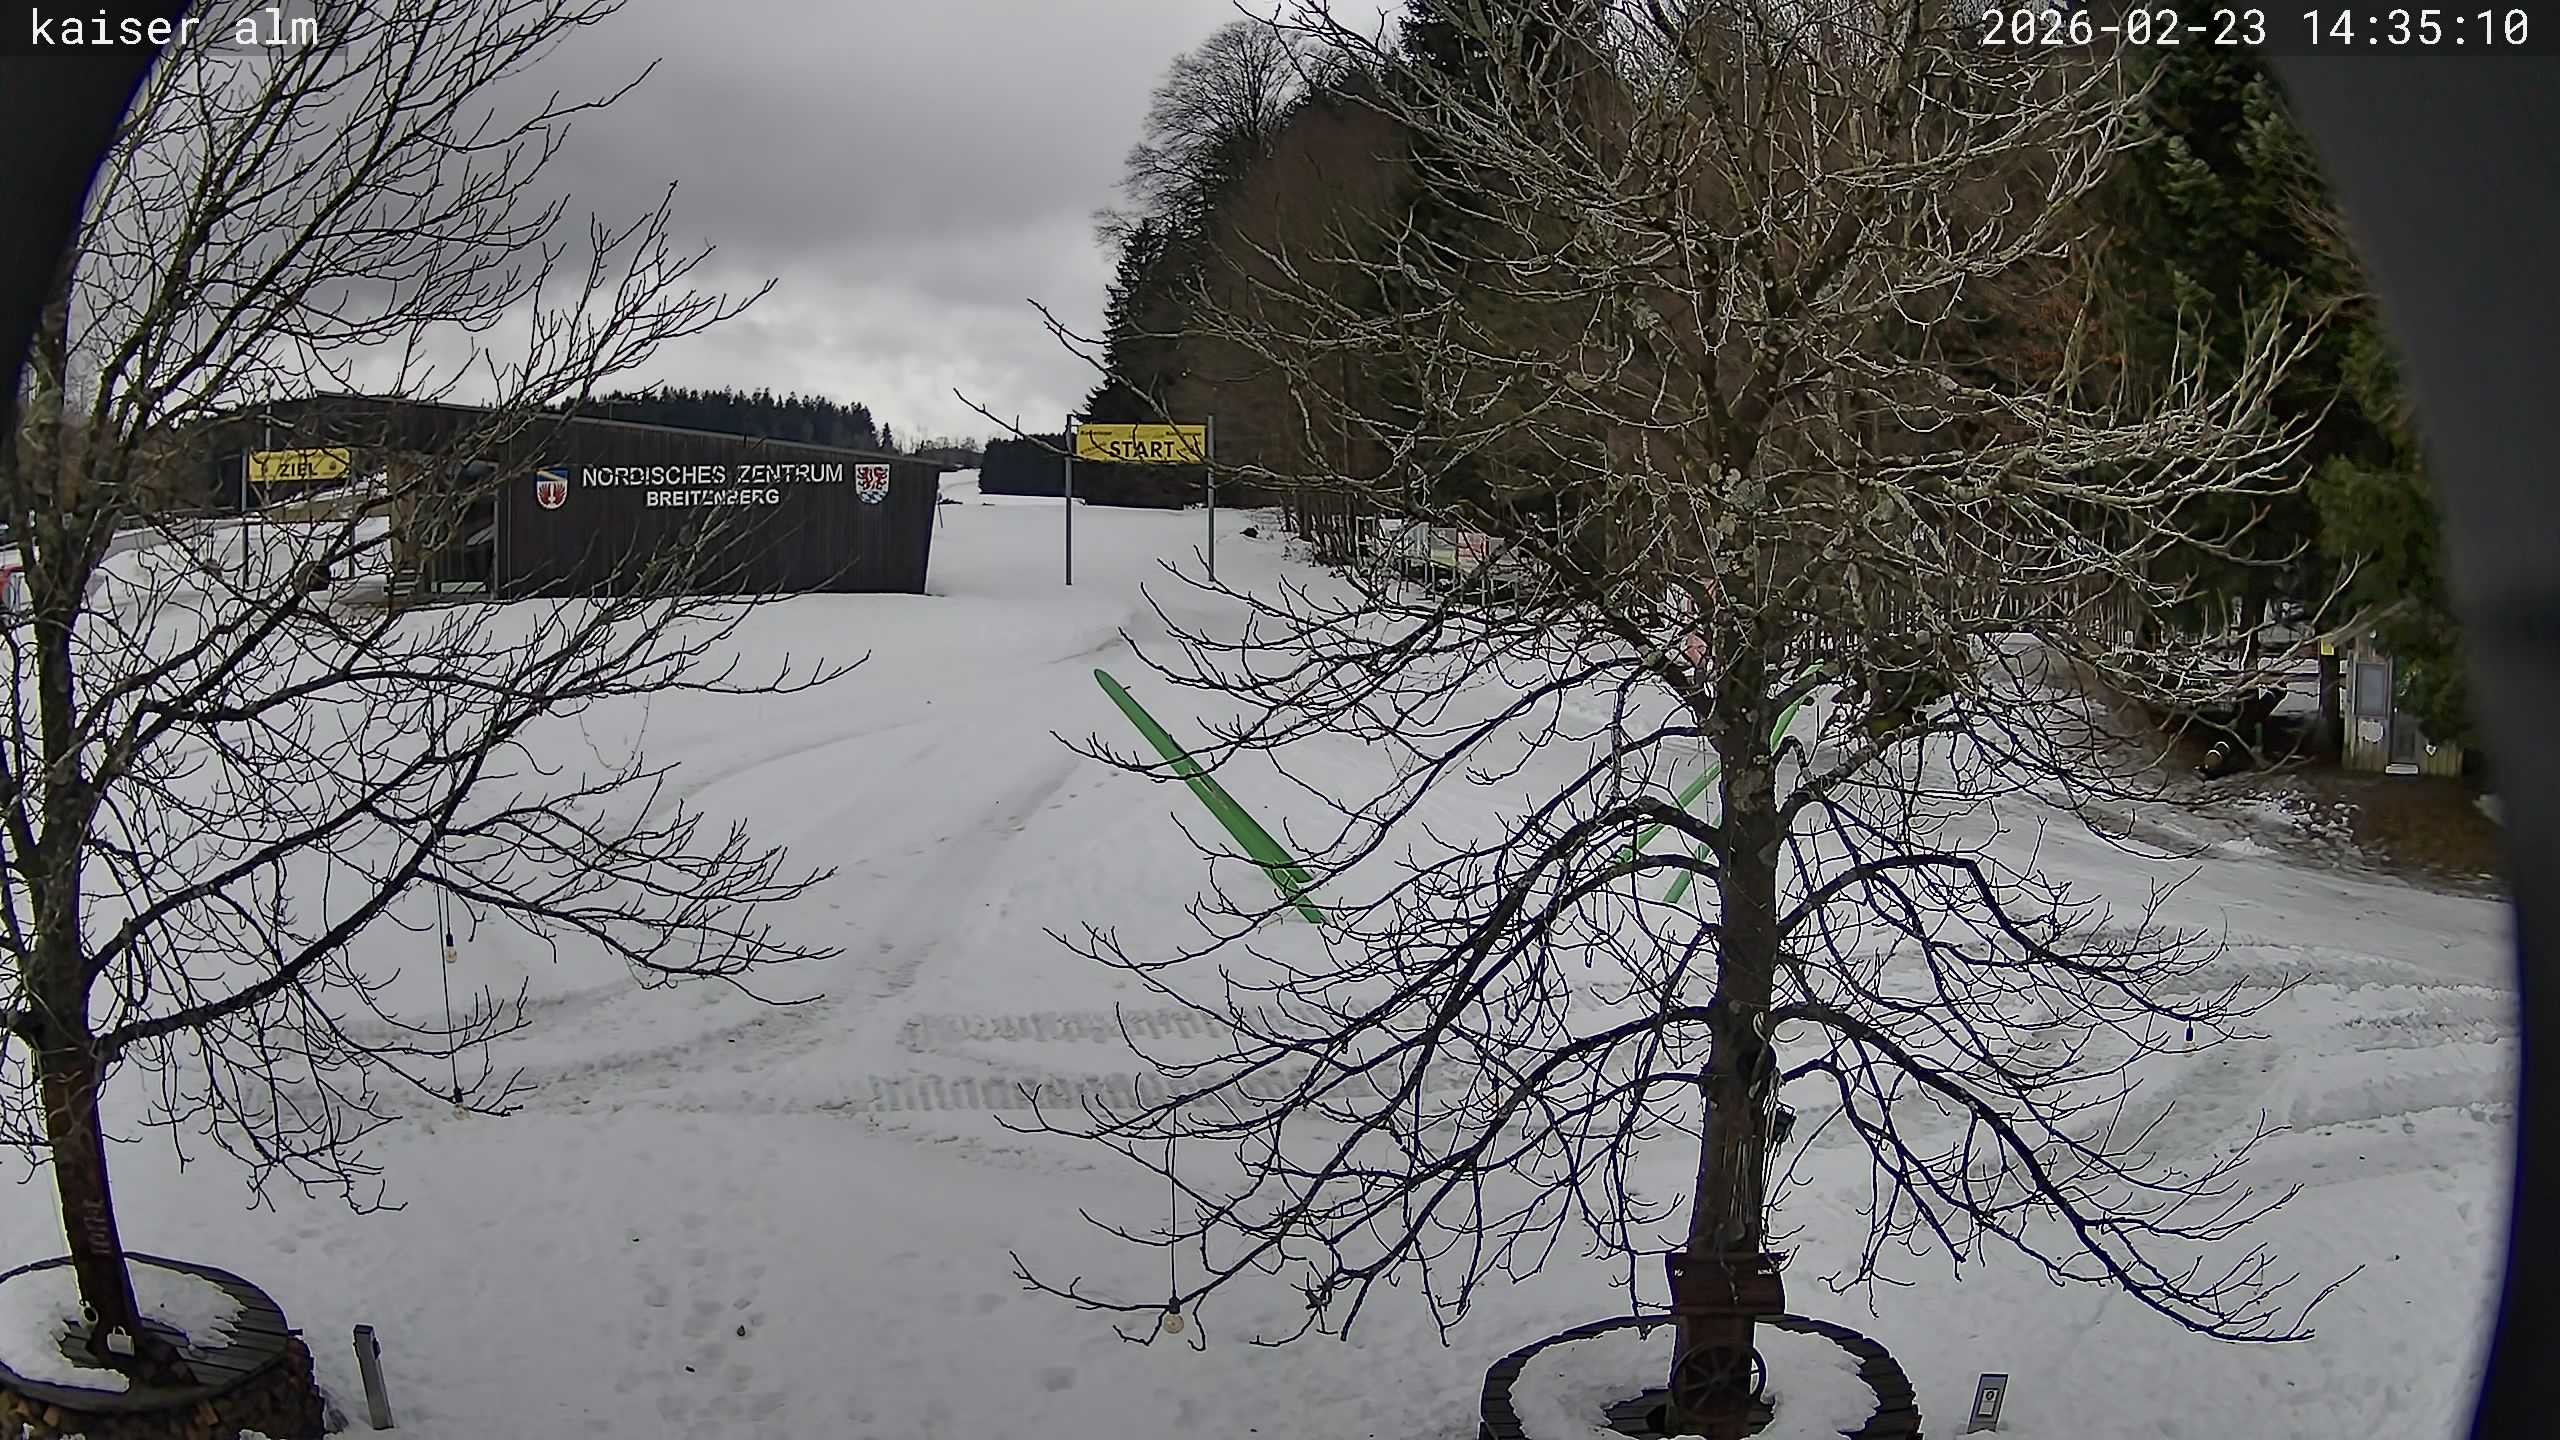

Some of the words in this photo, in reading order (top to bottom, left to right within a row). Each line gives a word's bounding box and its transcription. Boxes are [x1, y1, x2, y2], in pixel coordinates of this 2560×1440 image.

[1110, 441, 1175, 458] START
[279, 463, 319, 477] ZIEL
[582, 464, 726, 487] NORDISCHES
[737, 463, 843, 484] ZENTRUM
